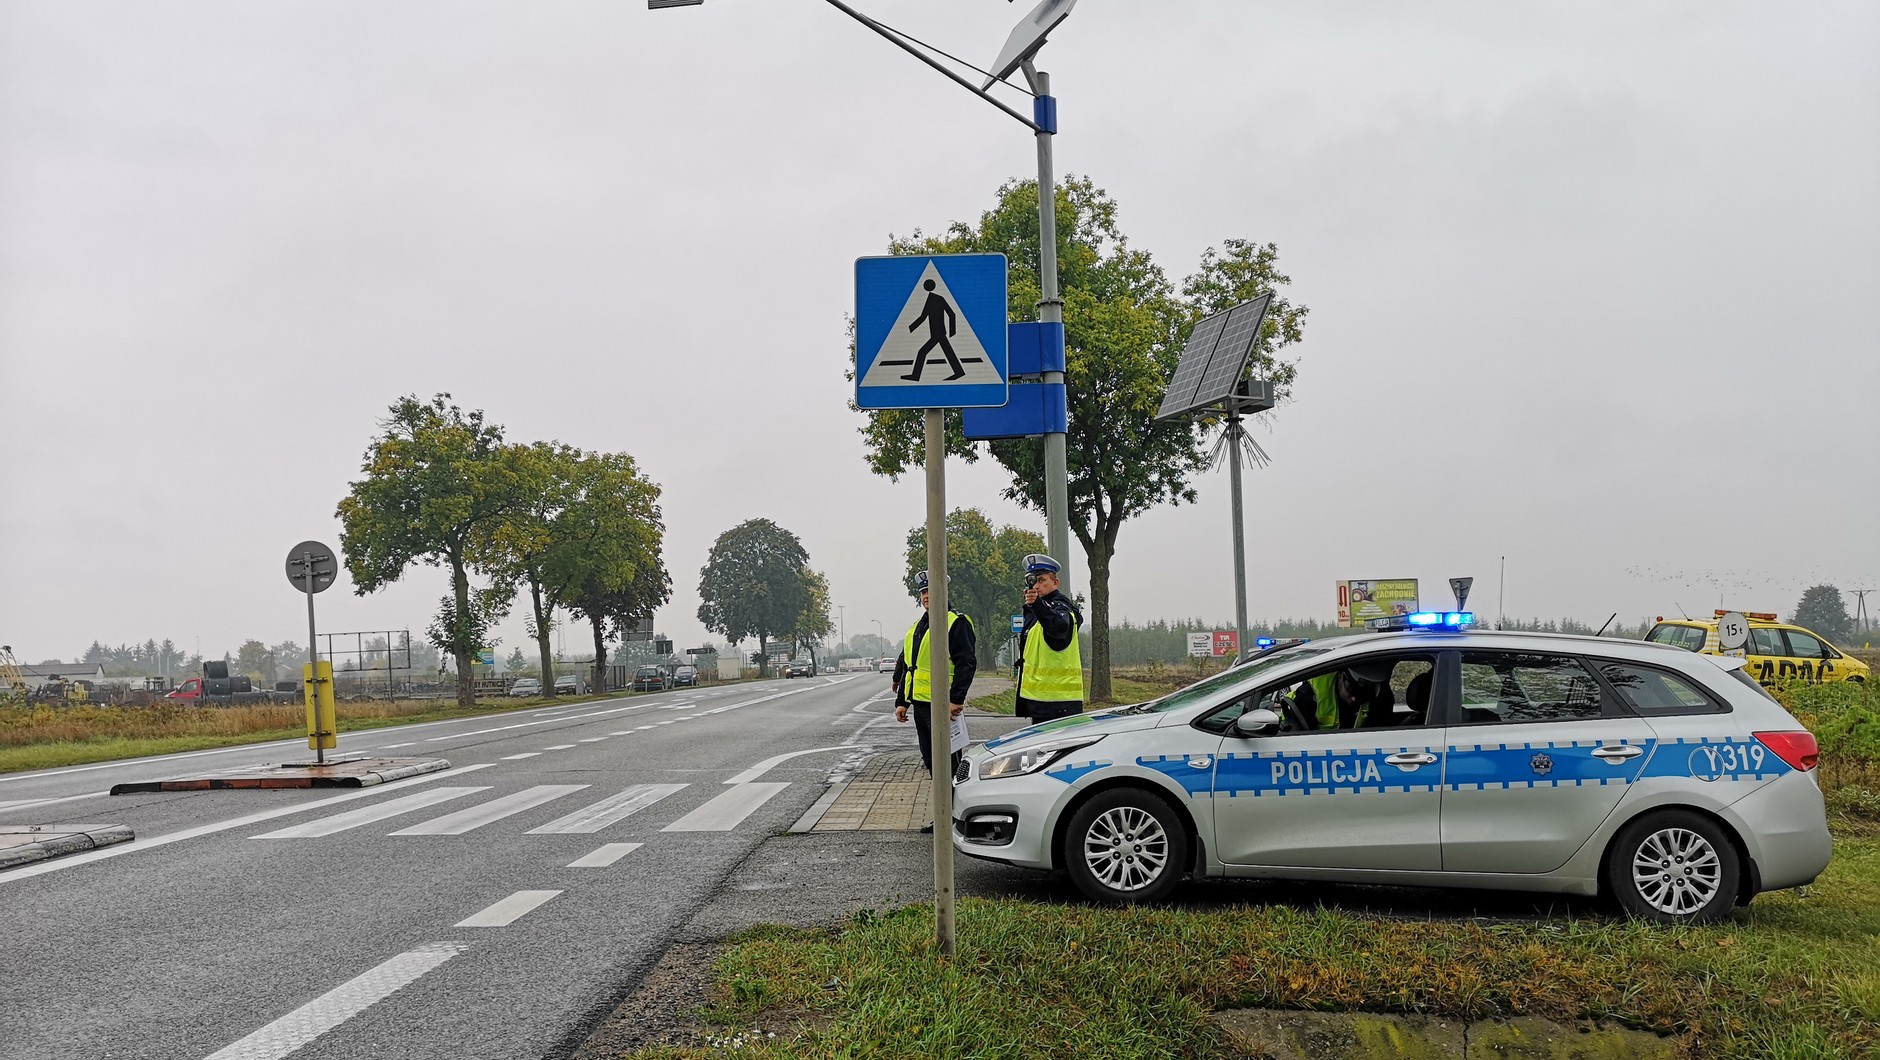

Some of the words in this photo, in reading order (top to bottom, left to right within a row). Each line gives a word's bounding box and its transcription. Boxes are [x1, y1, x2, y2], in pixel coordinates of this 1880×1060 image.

[1376, 590, 1415, 599] ZACHODNIE
[1726, 623, 1737, 637] 15
[1739, 627, 1743, 635] t
[1759, 659, 1833, 686] ADAC
[1703, 744, 1765, 772] Y319
[1271, 760, 1382, 785] POLICJA
